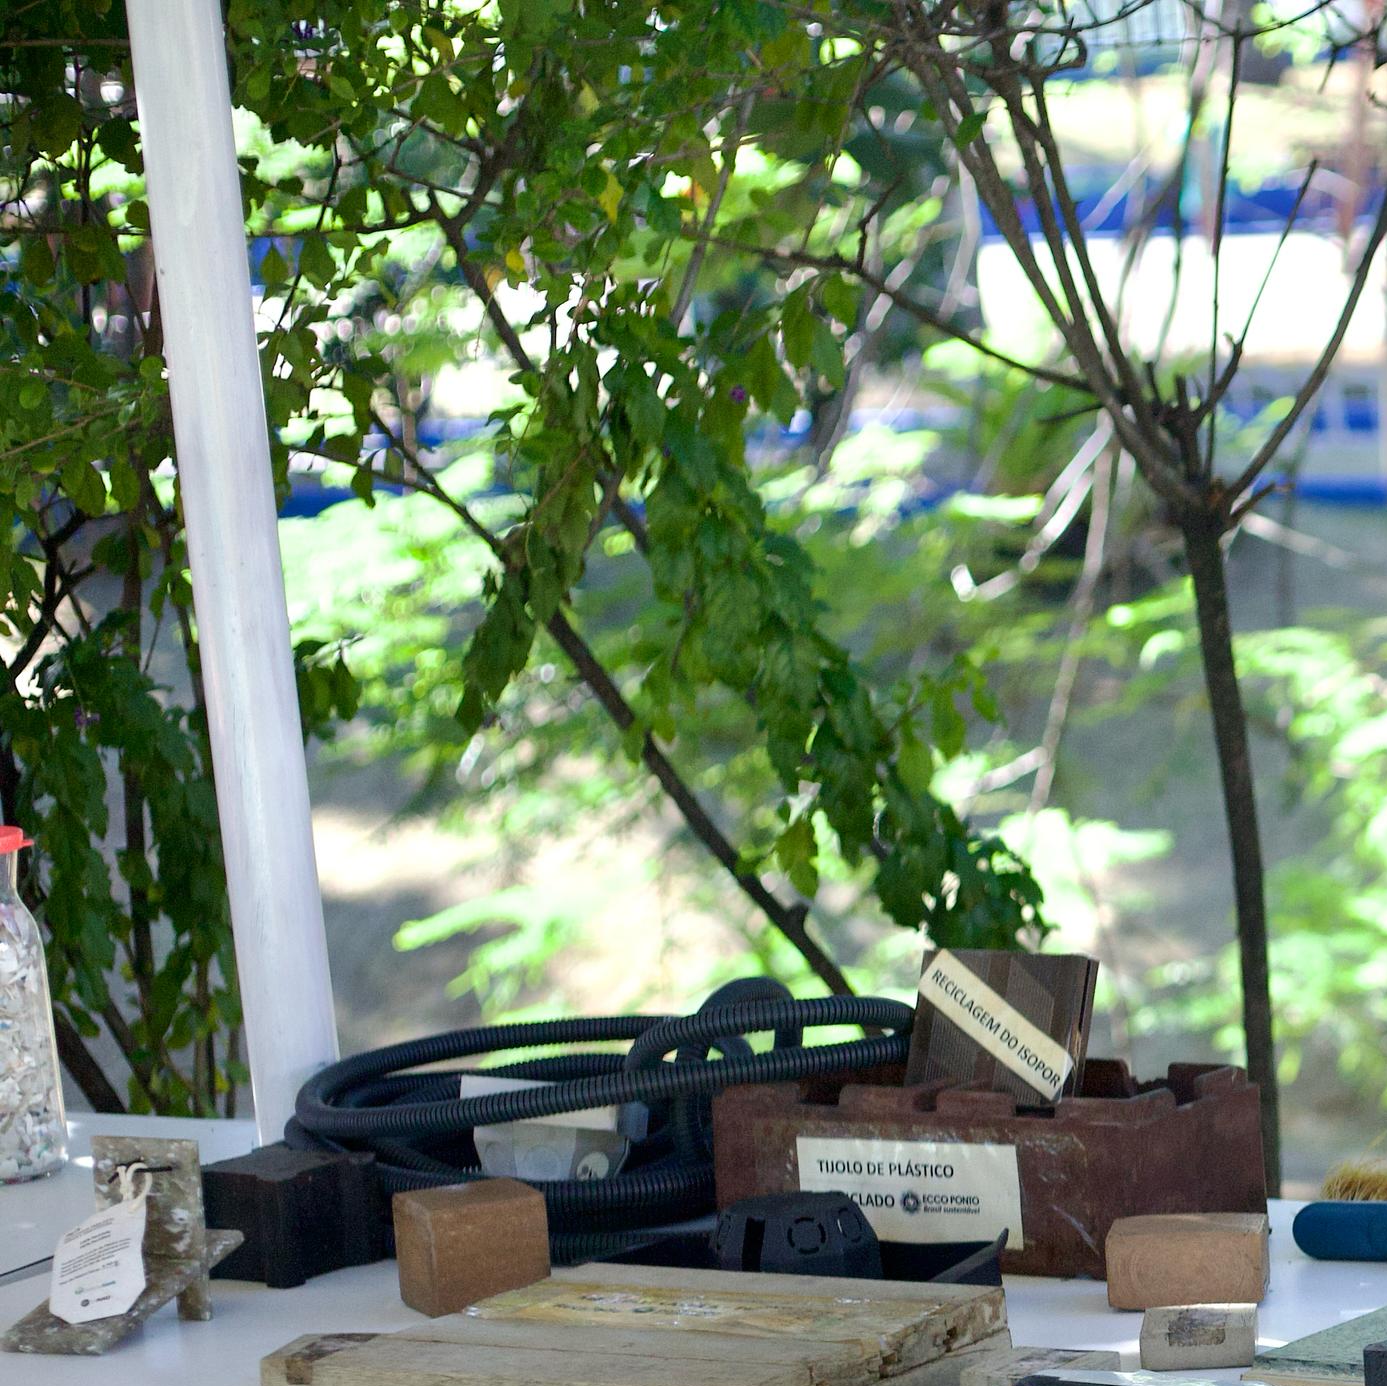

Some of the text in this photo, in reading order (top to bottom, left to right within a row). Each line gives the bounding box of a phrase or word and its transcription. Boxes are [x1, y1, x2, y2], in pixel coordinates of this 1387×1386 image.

[932, 969, 1061, 1088] RECICLAGEM DO ISOPOR
[817, 1159, 954, 1178] TIJOLO DE PLÁSTICO
[922, 1194, 980, 1206] ECCO PONTO
